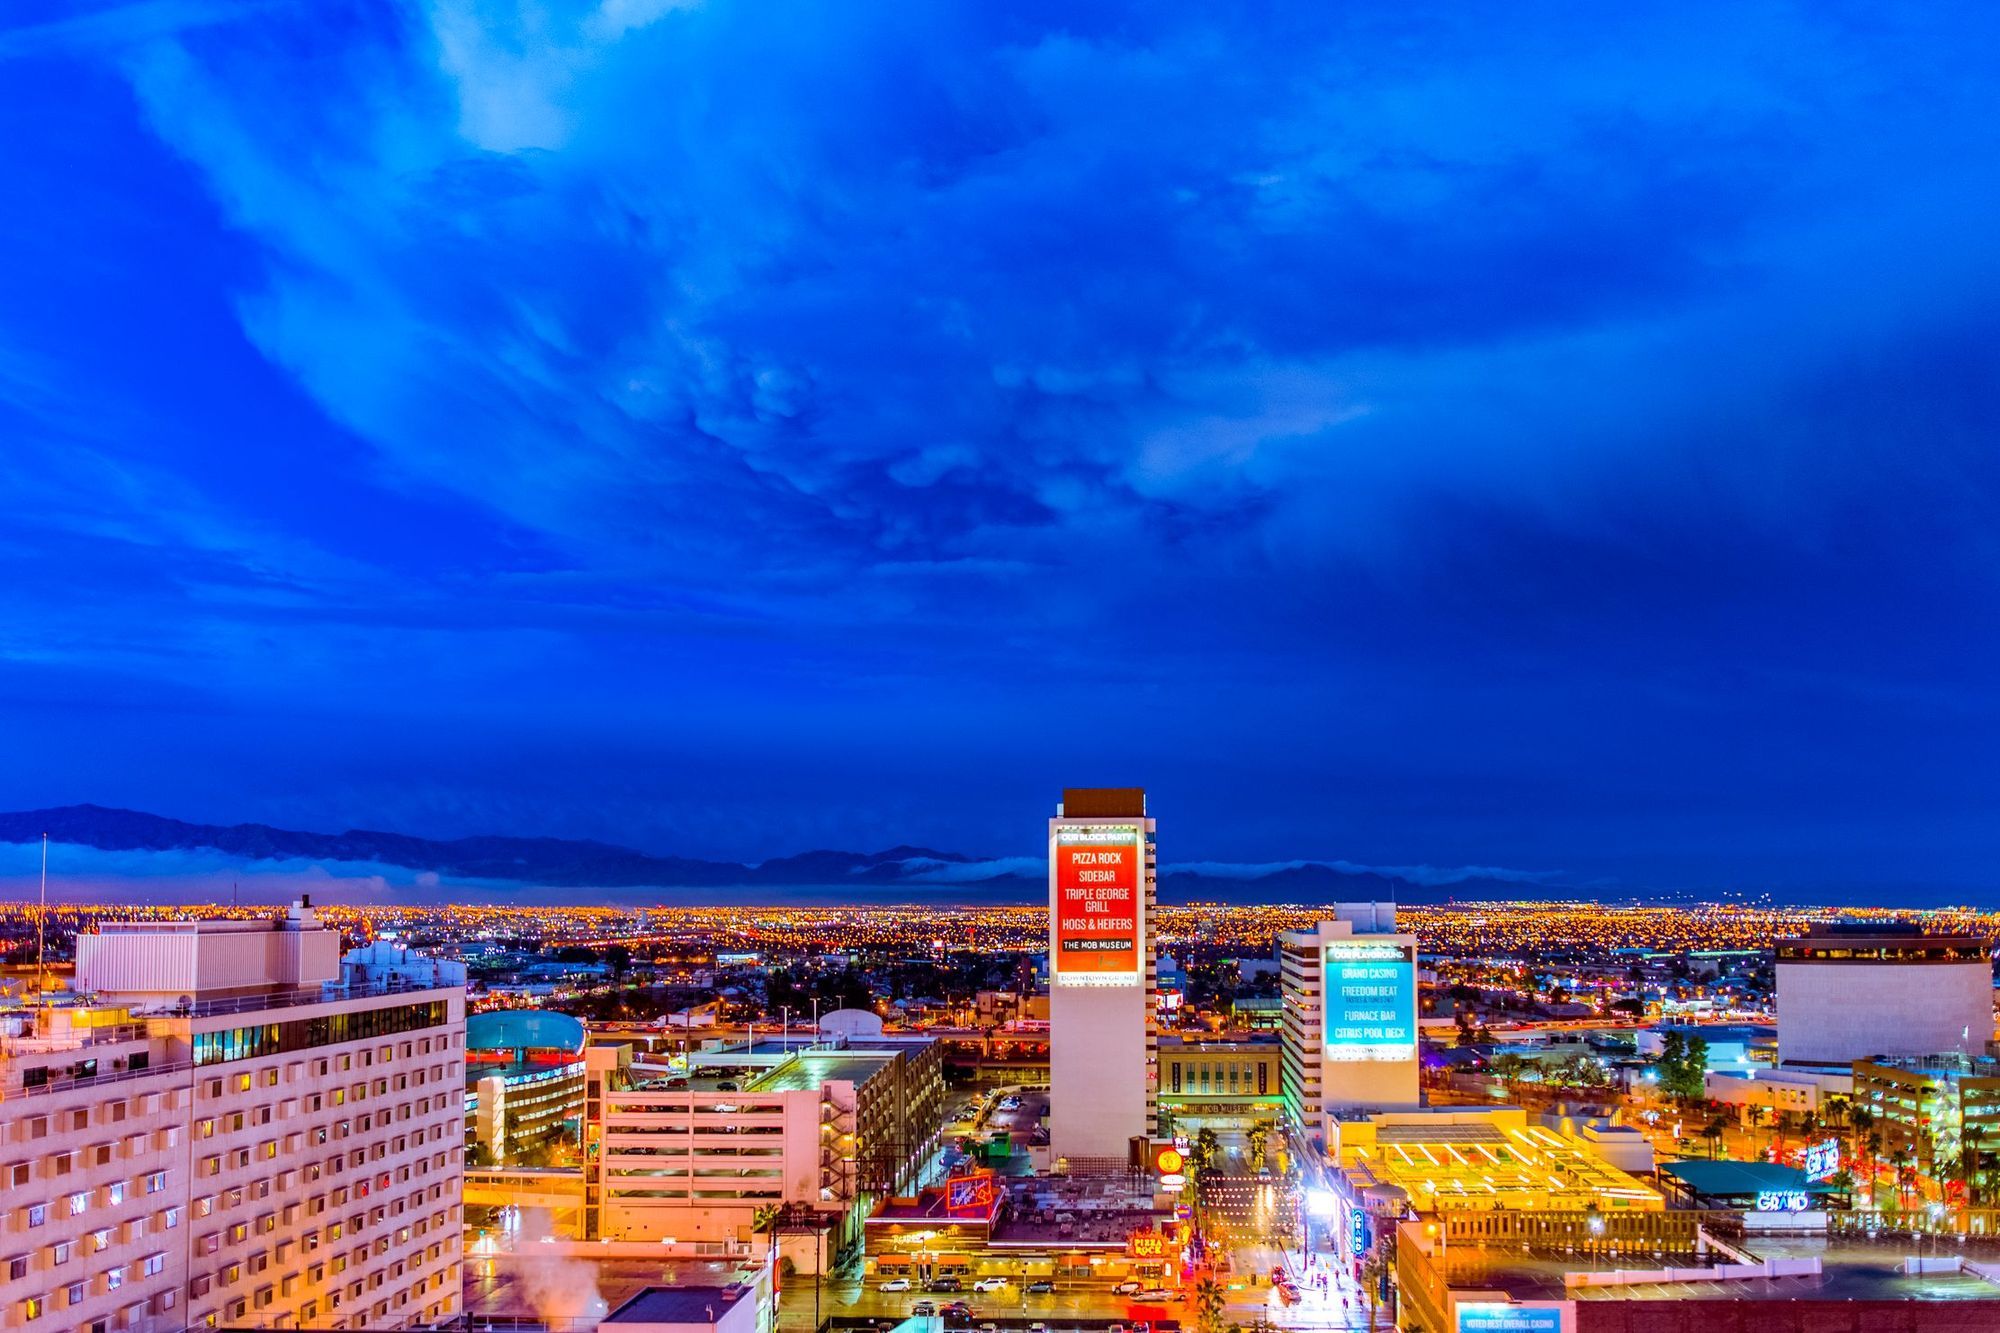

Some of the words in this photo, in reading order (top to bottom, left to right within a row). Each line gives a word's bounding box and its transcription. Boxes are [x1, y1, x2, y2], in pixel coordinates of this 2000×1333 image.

[1062, 833, 1078, 841] OUR
[1080, 833, 1106, 841] BLOCK
[1107, 833, 1132, 841] PARTY
[1072, 852, 1096, 864] PIZZA
[1098, 852, 1122, 864] ROCK
[1079, 870, 1116, 882] SIDEBAR
[1065, 888, 1094, 900] TRIPLE
[1096, 888, 1130, 900] GEORGE
[1086, 901, 1110, 912] GRILL
[1062, 918, 1086, 930] HOGS
[1088, 918, 1096, 930] &
[1098, 918, 1132, 930] HEIFERS
[1064, 941, 1081, 949] THE
[1082, 941, 1098, 949] MOB
[1100, 941, 1132, 949] MUSEUM
[1352, 950, 1404, 959] PLAYGROUND
[1342, 968, 1368, 979] GRAND
[1369, 968, 1398, 979] CASINO
[1342, 986, 1378, 996] FREEDOM
[1380, 986, 1398, 996] BEAT
[1344, 1010, 1378, 1021] FURNACE
[1380, 1010, 1396, 1021] BAR
[1335, 1028, 1362, 1038] CITRUS
[1364, 1028, 1384, 1038] POOL
[1385, 1028, 1406, 1038] DECK
[1184, 1104, 1200, 1113] THE
[1202, 1104, 1218, 1113] MOB
[1220, 1104, 1254, 1113] MUSEUM
[1757, 1196, 1808, 1211] GRAND
[938, 1228, 958, 1237] Craft
[1134, 1238, 1162, 1247] PIZZA
[1136, 1246, 1162, 1256] ROCK
[1466, 1320, 1486, 1329] VOTED
[1488, 1320, 1502, 1329] BEST
[1503, 1320, 1530, 1329] OVERALL
[1531, 1320, 1554, 1329] CASINO
